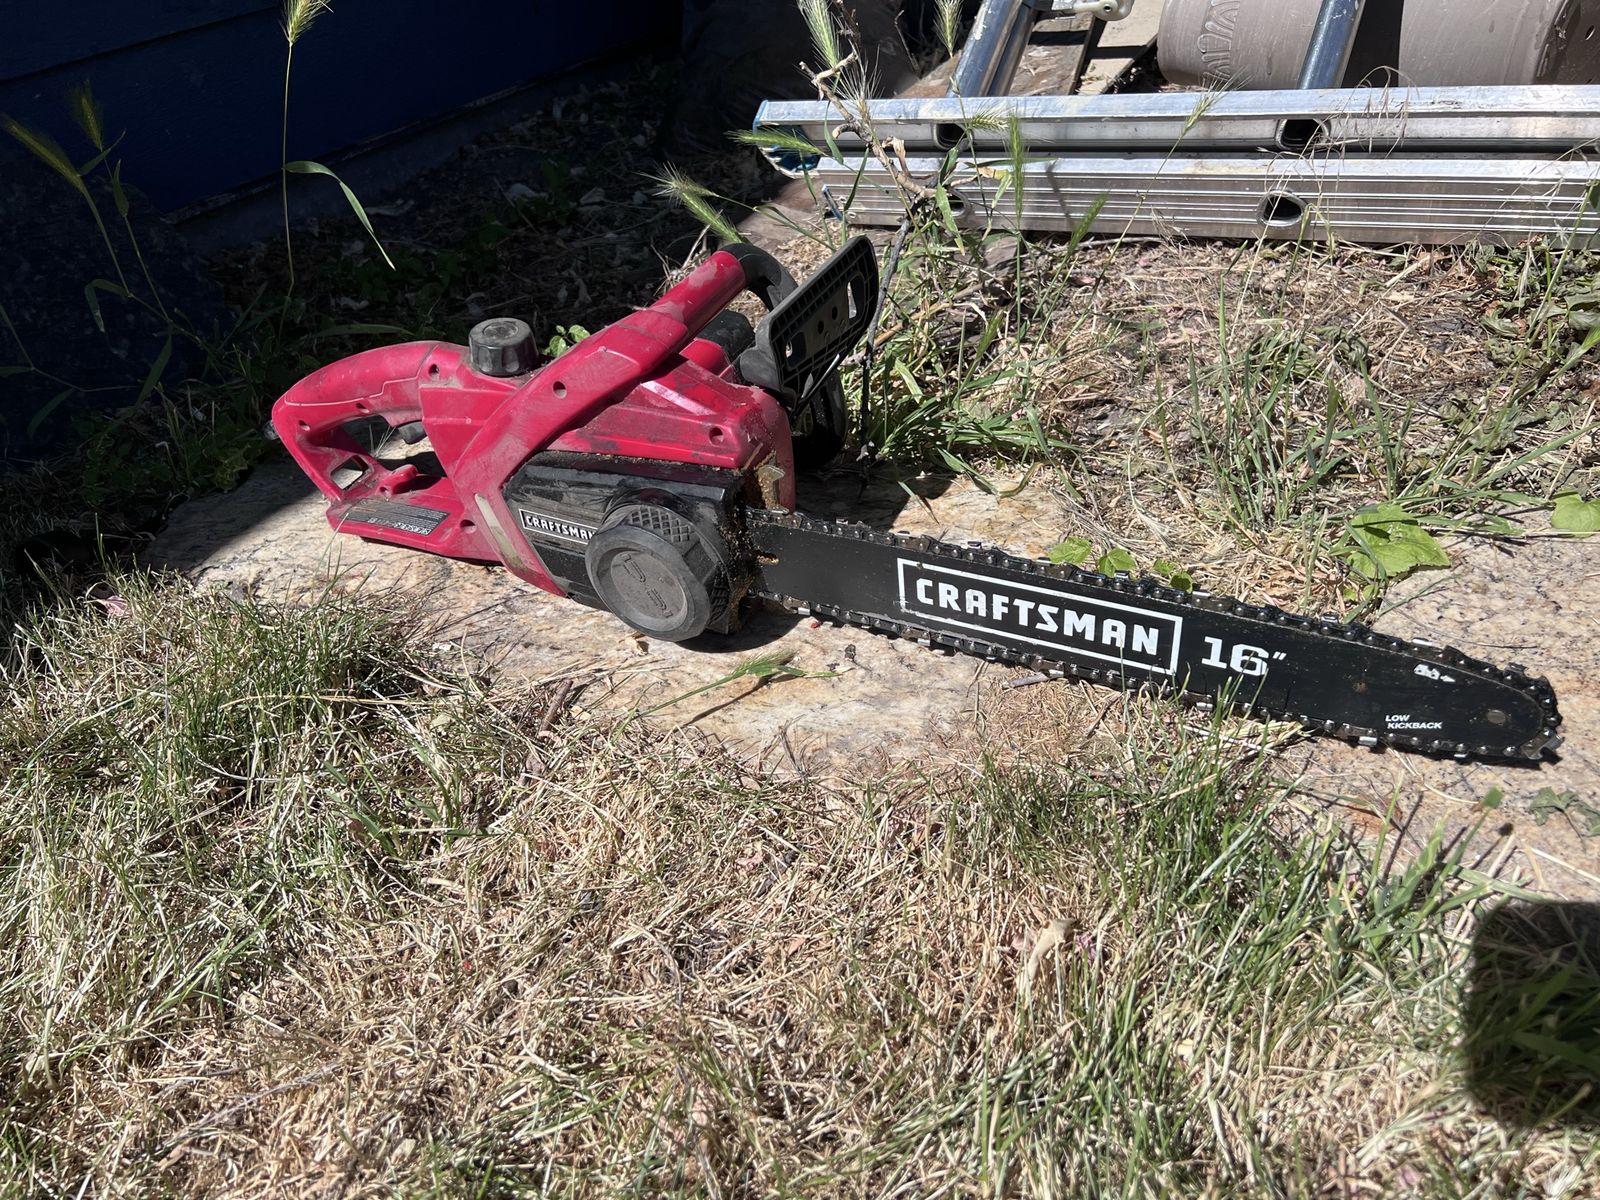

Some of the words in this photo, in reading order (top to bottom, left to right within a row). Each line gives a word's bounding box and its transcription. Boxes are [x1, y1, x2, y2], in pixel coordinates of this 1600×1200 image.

[916, 577, 1159, 656] CRAFTSMAN
[1201, 635, 1287, 676] 16"
[1385, 714, 1410, 722] LOW
